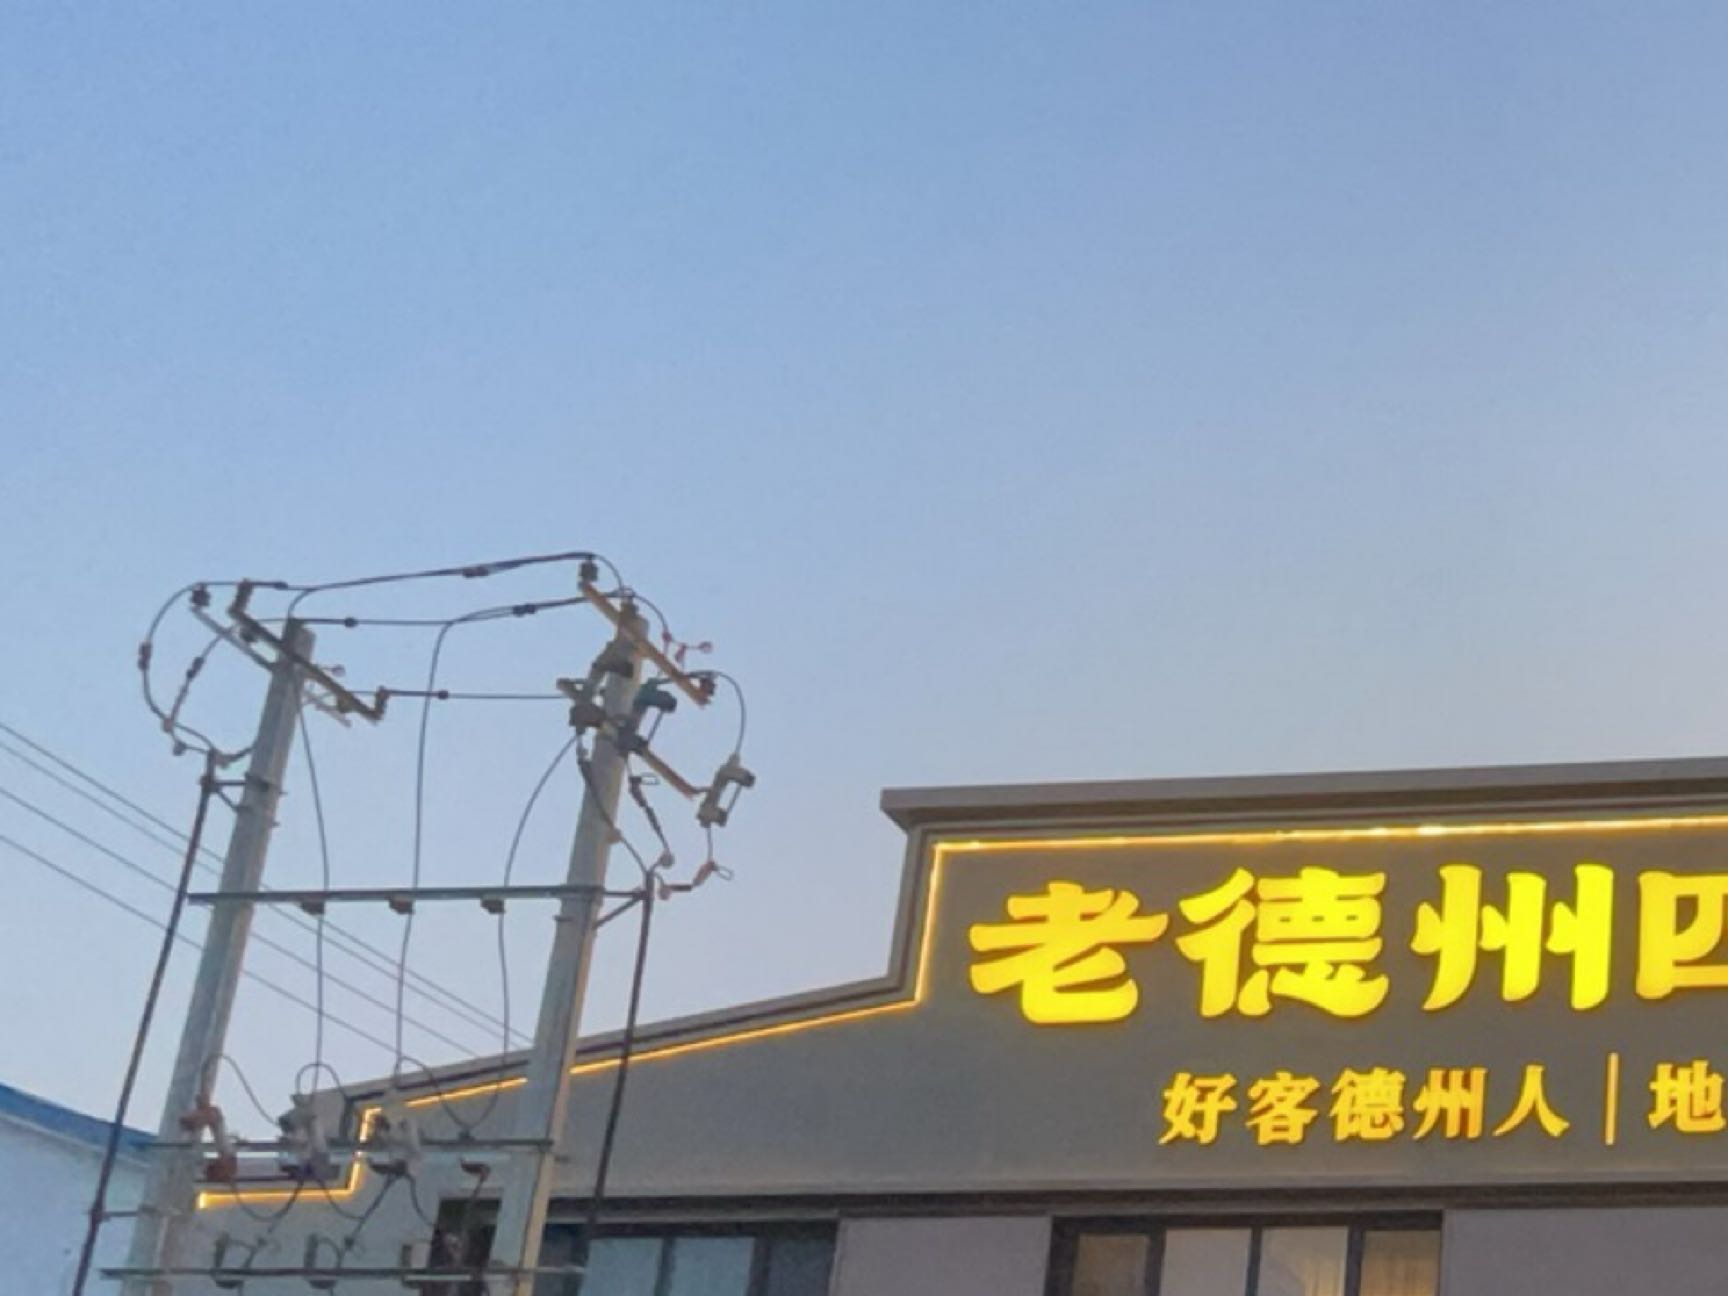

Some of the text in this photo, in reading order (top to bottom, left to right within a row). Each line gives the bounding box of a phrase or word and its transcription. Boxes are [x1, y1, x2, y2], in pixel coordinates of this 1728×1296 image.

[1158, 1065, 1570, 1147] 好客德州人
